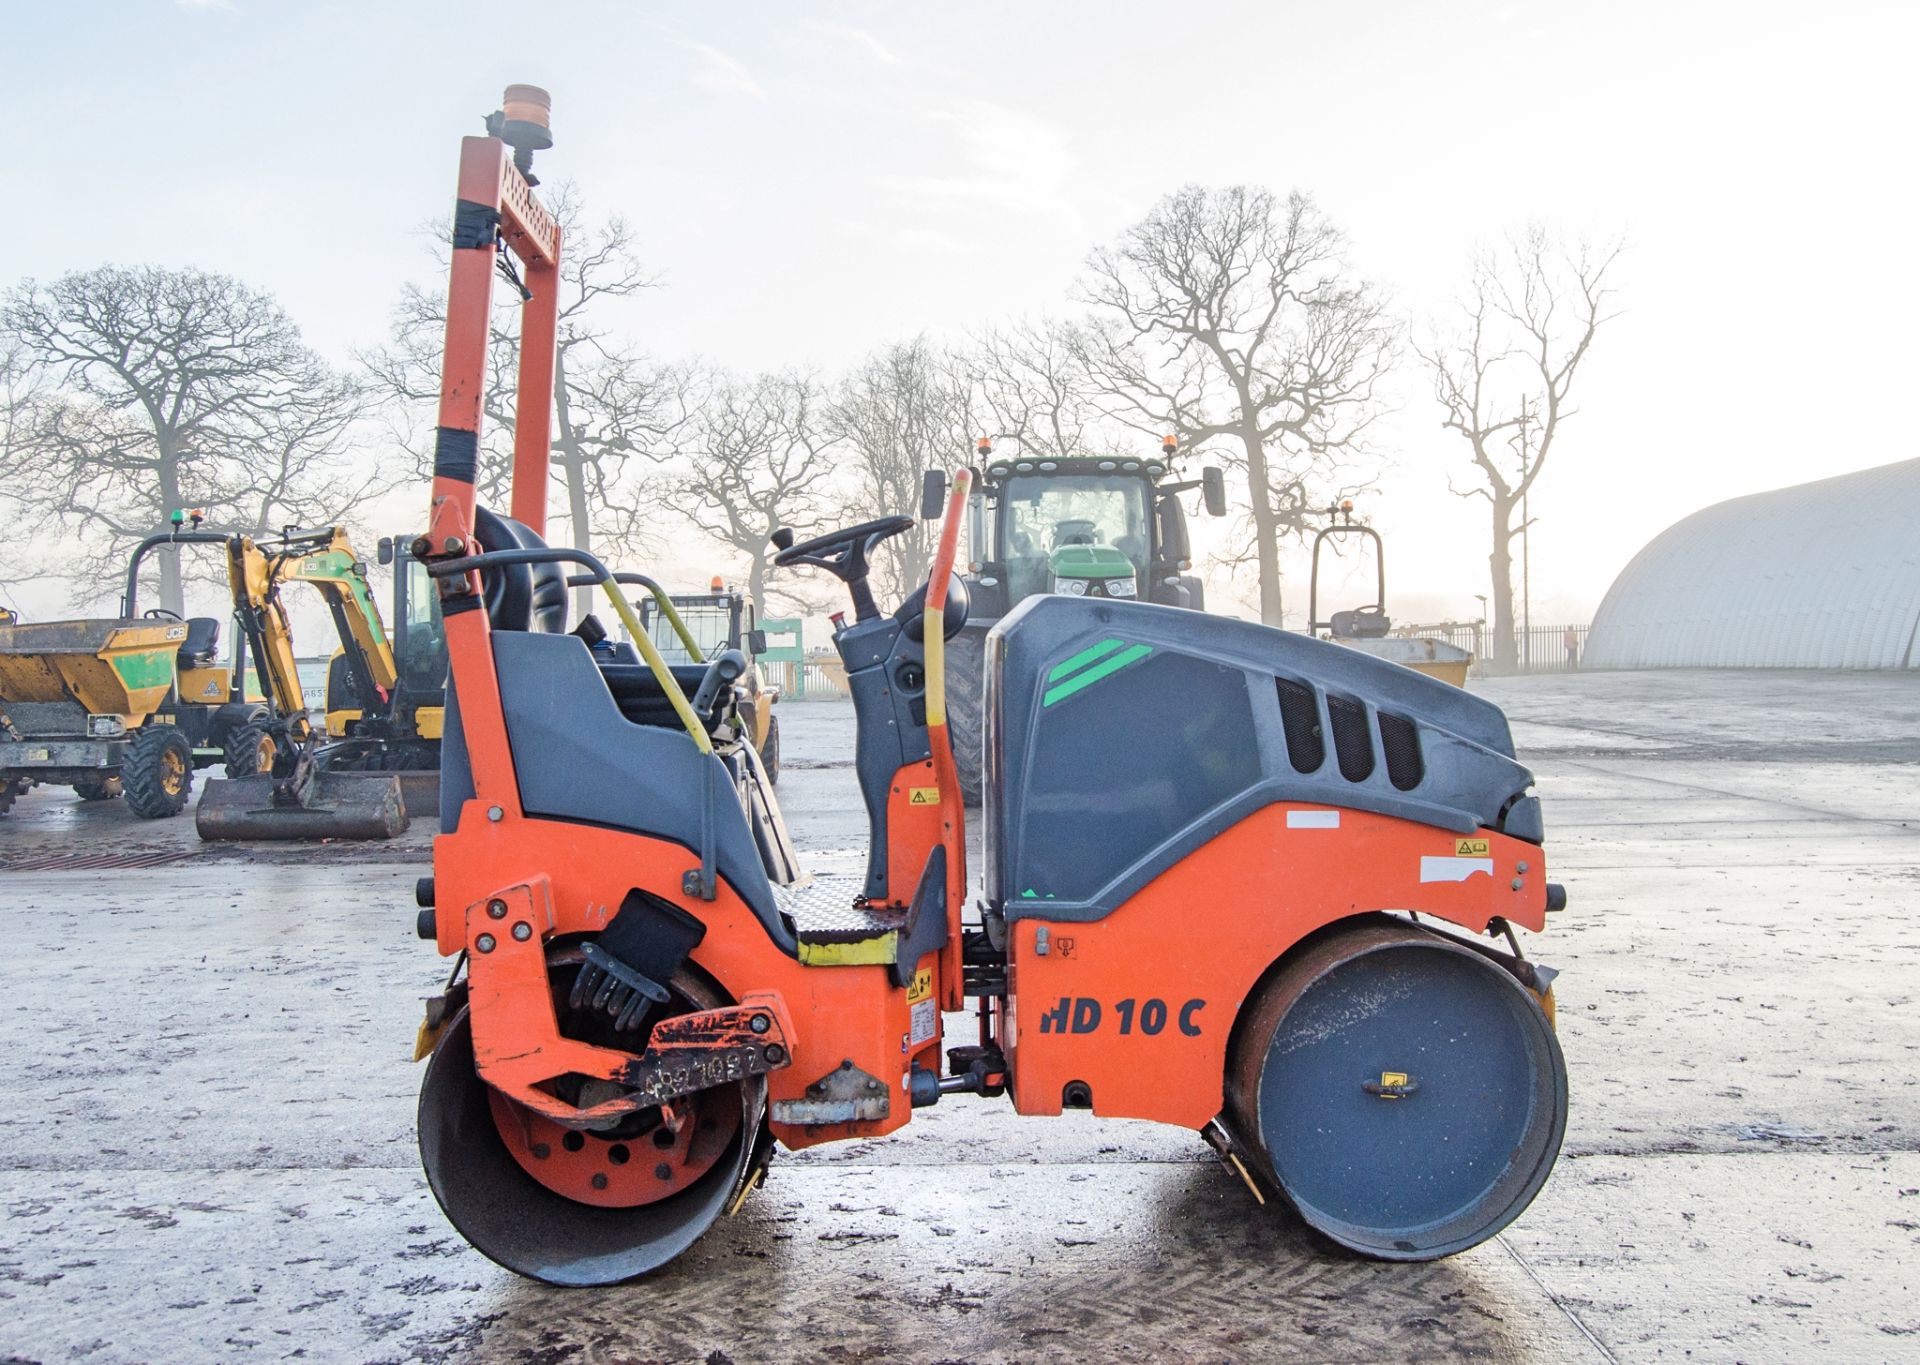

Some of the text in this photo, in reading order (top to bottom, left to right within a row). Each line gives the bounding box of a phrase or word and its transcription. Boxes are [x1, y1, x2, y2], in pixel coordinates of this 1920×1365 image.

[166, 626, 185, 639] JCB
[1040, 998, 1207, 1037] HD 10 C
